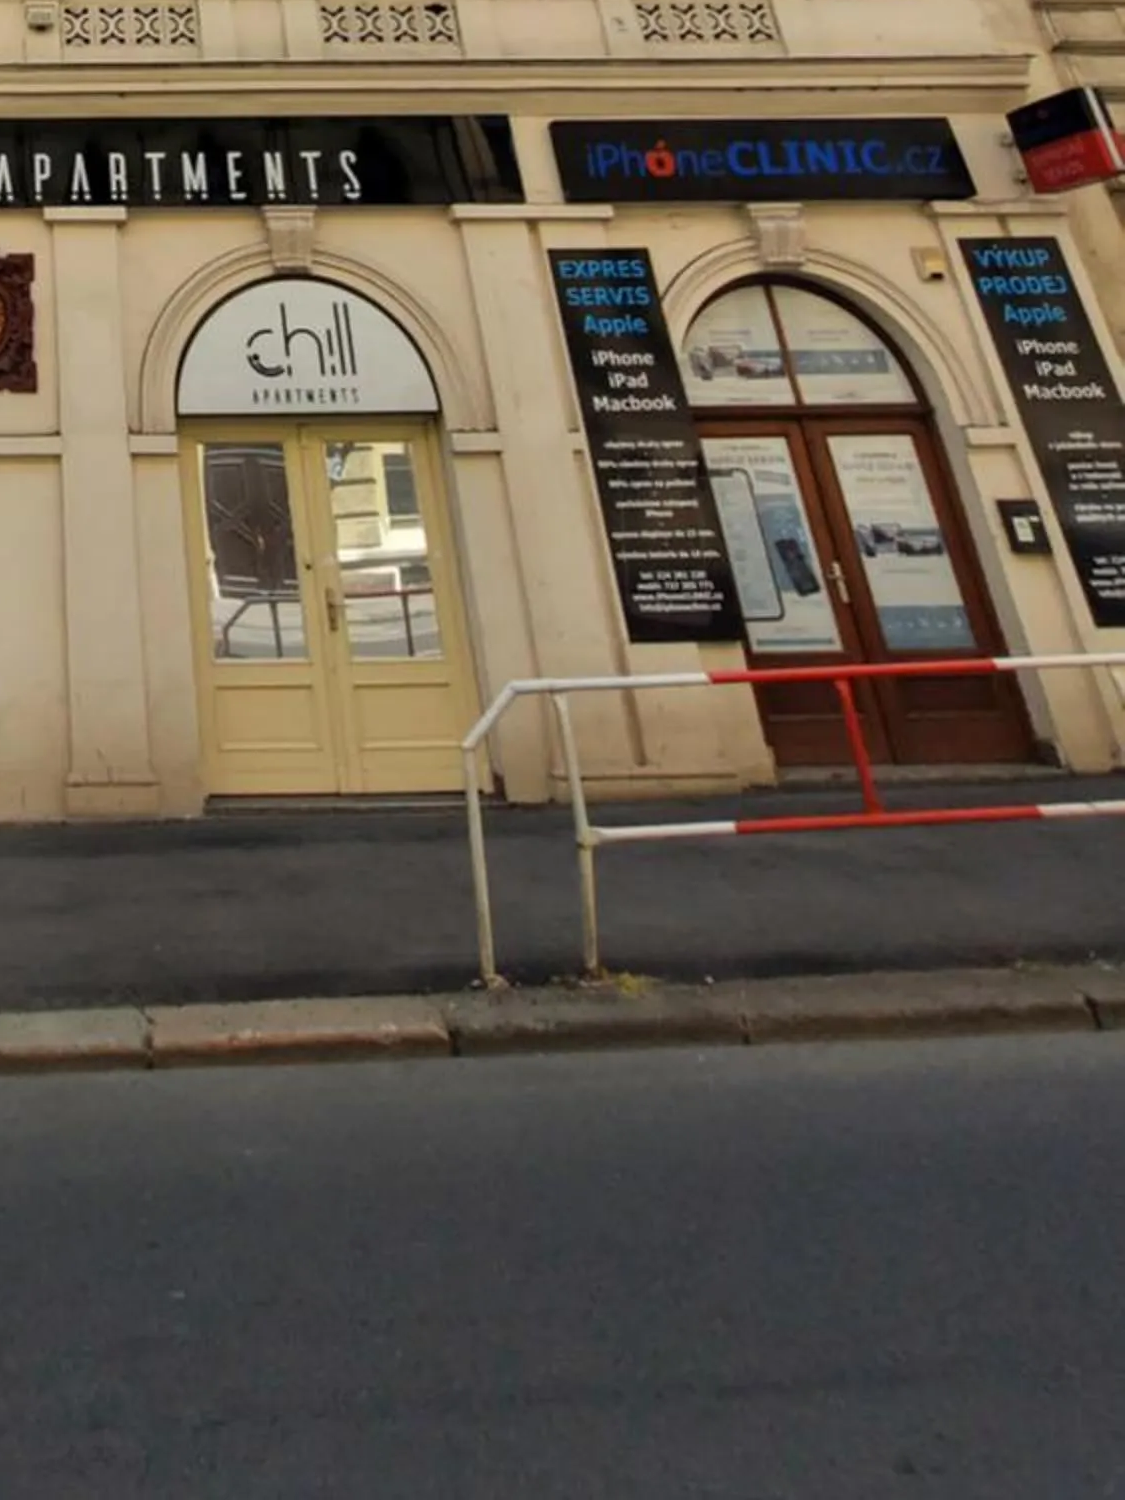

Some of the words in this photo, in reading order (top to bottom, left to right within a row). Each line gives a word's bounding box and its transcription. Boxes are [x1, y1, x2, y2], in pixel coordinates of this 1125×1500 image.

[972, 244, 1050, 267] VÝKUP
[557, 259, 646, 279] EXPRES
[977, 275, 1068, 295] PRODEJ
[566, 286, 651, 306] SERVIS
[1003, 302, 1068, 327] Apple
[583, 314, 649, 337] Apple
[246, 301, 357, 377] chill
[1015, 338, 1081, 356] iPhone
[591, 349, 655, 366] iPhone
[1035, 360, 1078, 377] iPad
[607, 371, 650, 389] iPad
[1023, 382, 1107, 400] Macbook
[592, 393, 677, 412] Macbook
